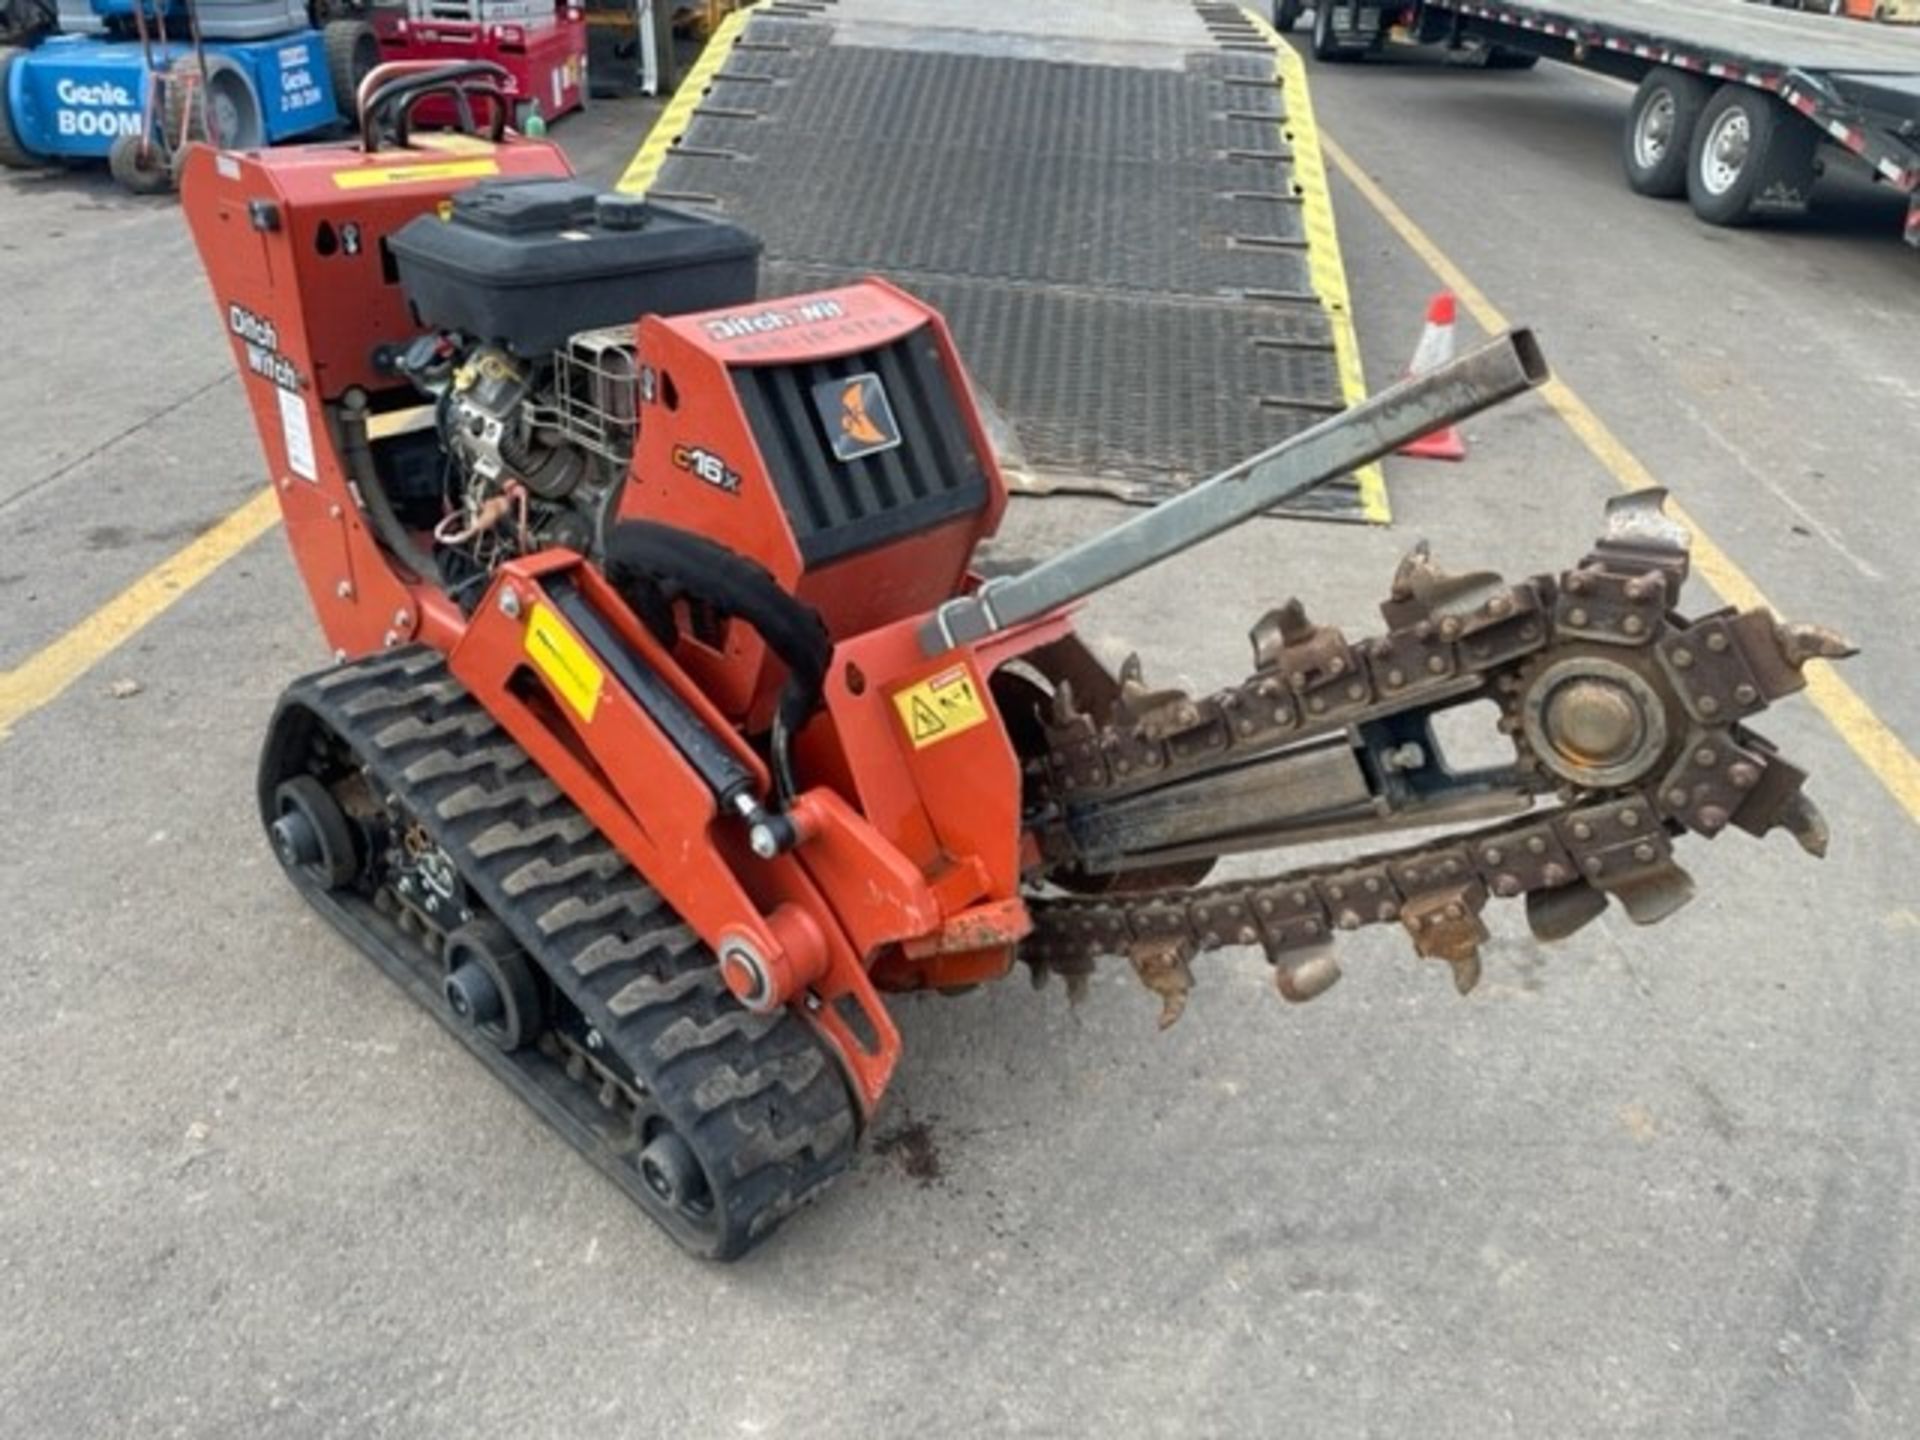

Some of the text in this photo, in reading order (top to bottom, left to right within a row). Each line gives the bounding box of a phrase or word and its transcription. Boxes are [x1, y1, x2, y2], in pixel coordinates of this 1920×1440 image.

[57, 79, 131, 106] Genie
[58, 110, 142, 135] BOOM
[228, 303, 278, 351] Ditch
[246, 345, 299, 391] Witch
